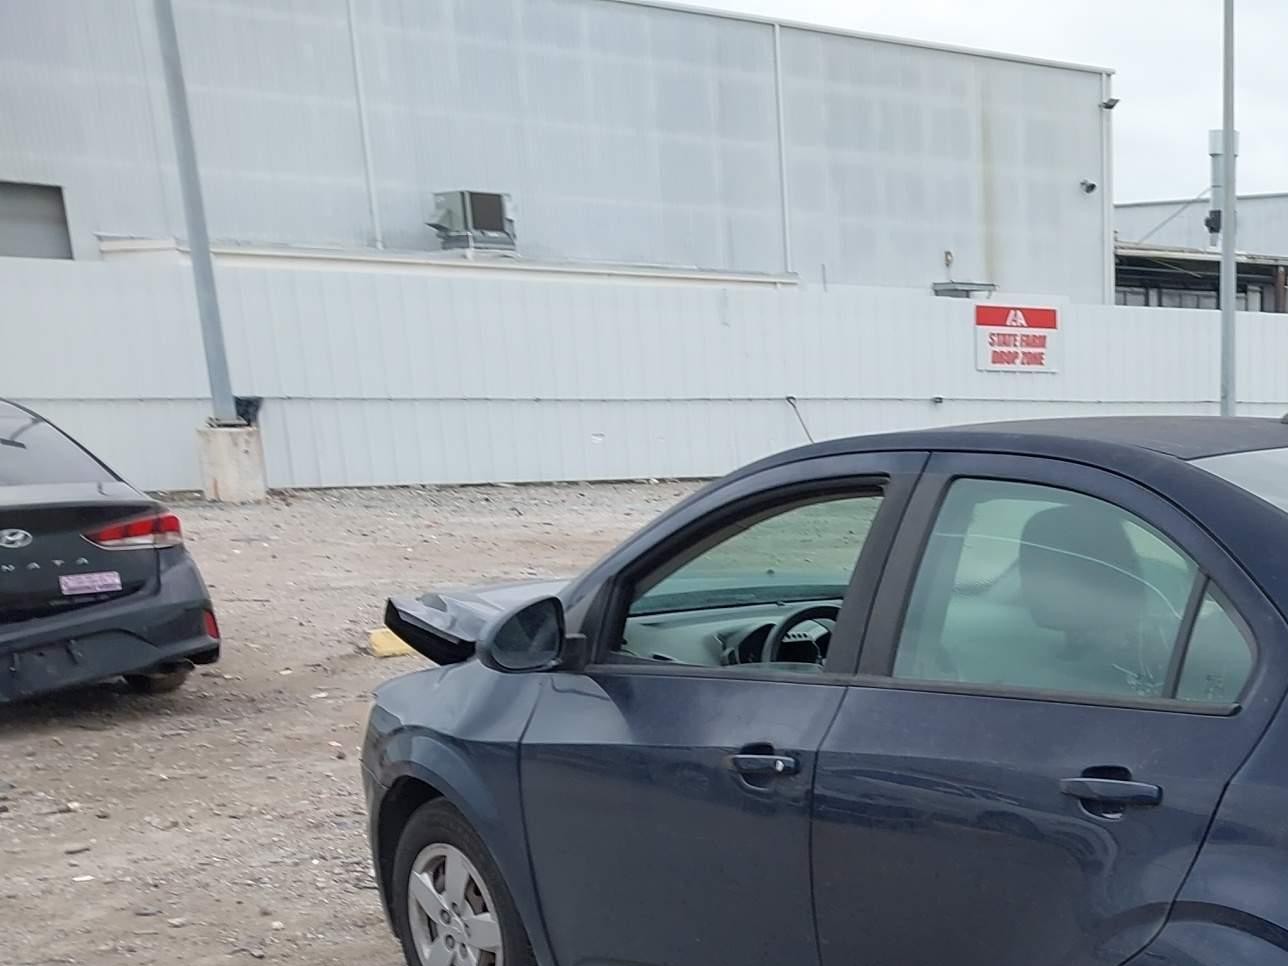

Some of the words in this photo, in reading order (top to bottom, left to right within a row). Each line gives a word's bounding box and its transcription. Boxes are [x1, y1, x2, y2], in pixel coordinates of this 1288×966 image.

[988, 332, 1019, 348] STATE
[1020, 333, 1047, 349] FARM
[991, 350, 1019, 365] DROP
[1020, 351, 1045, 366] ZONE
